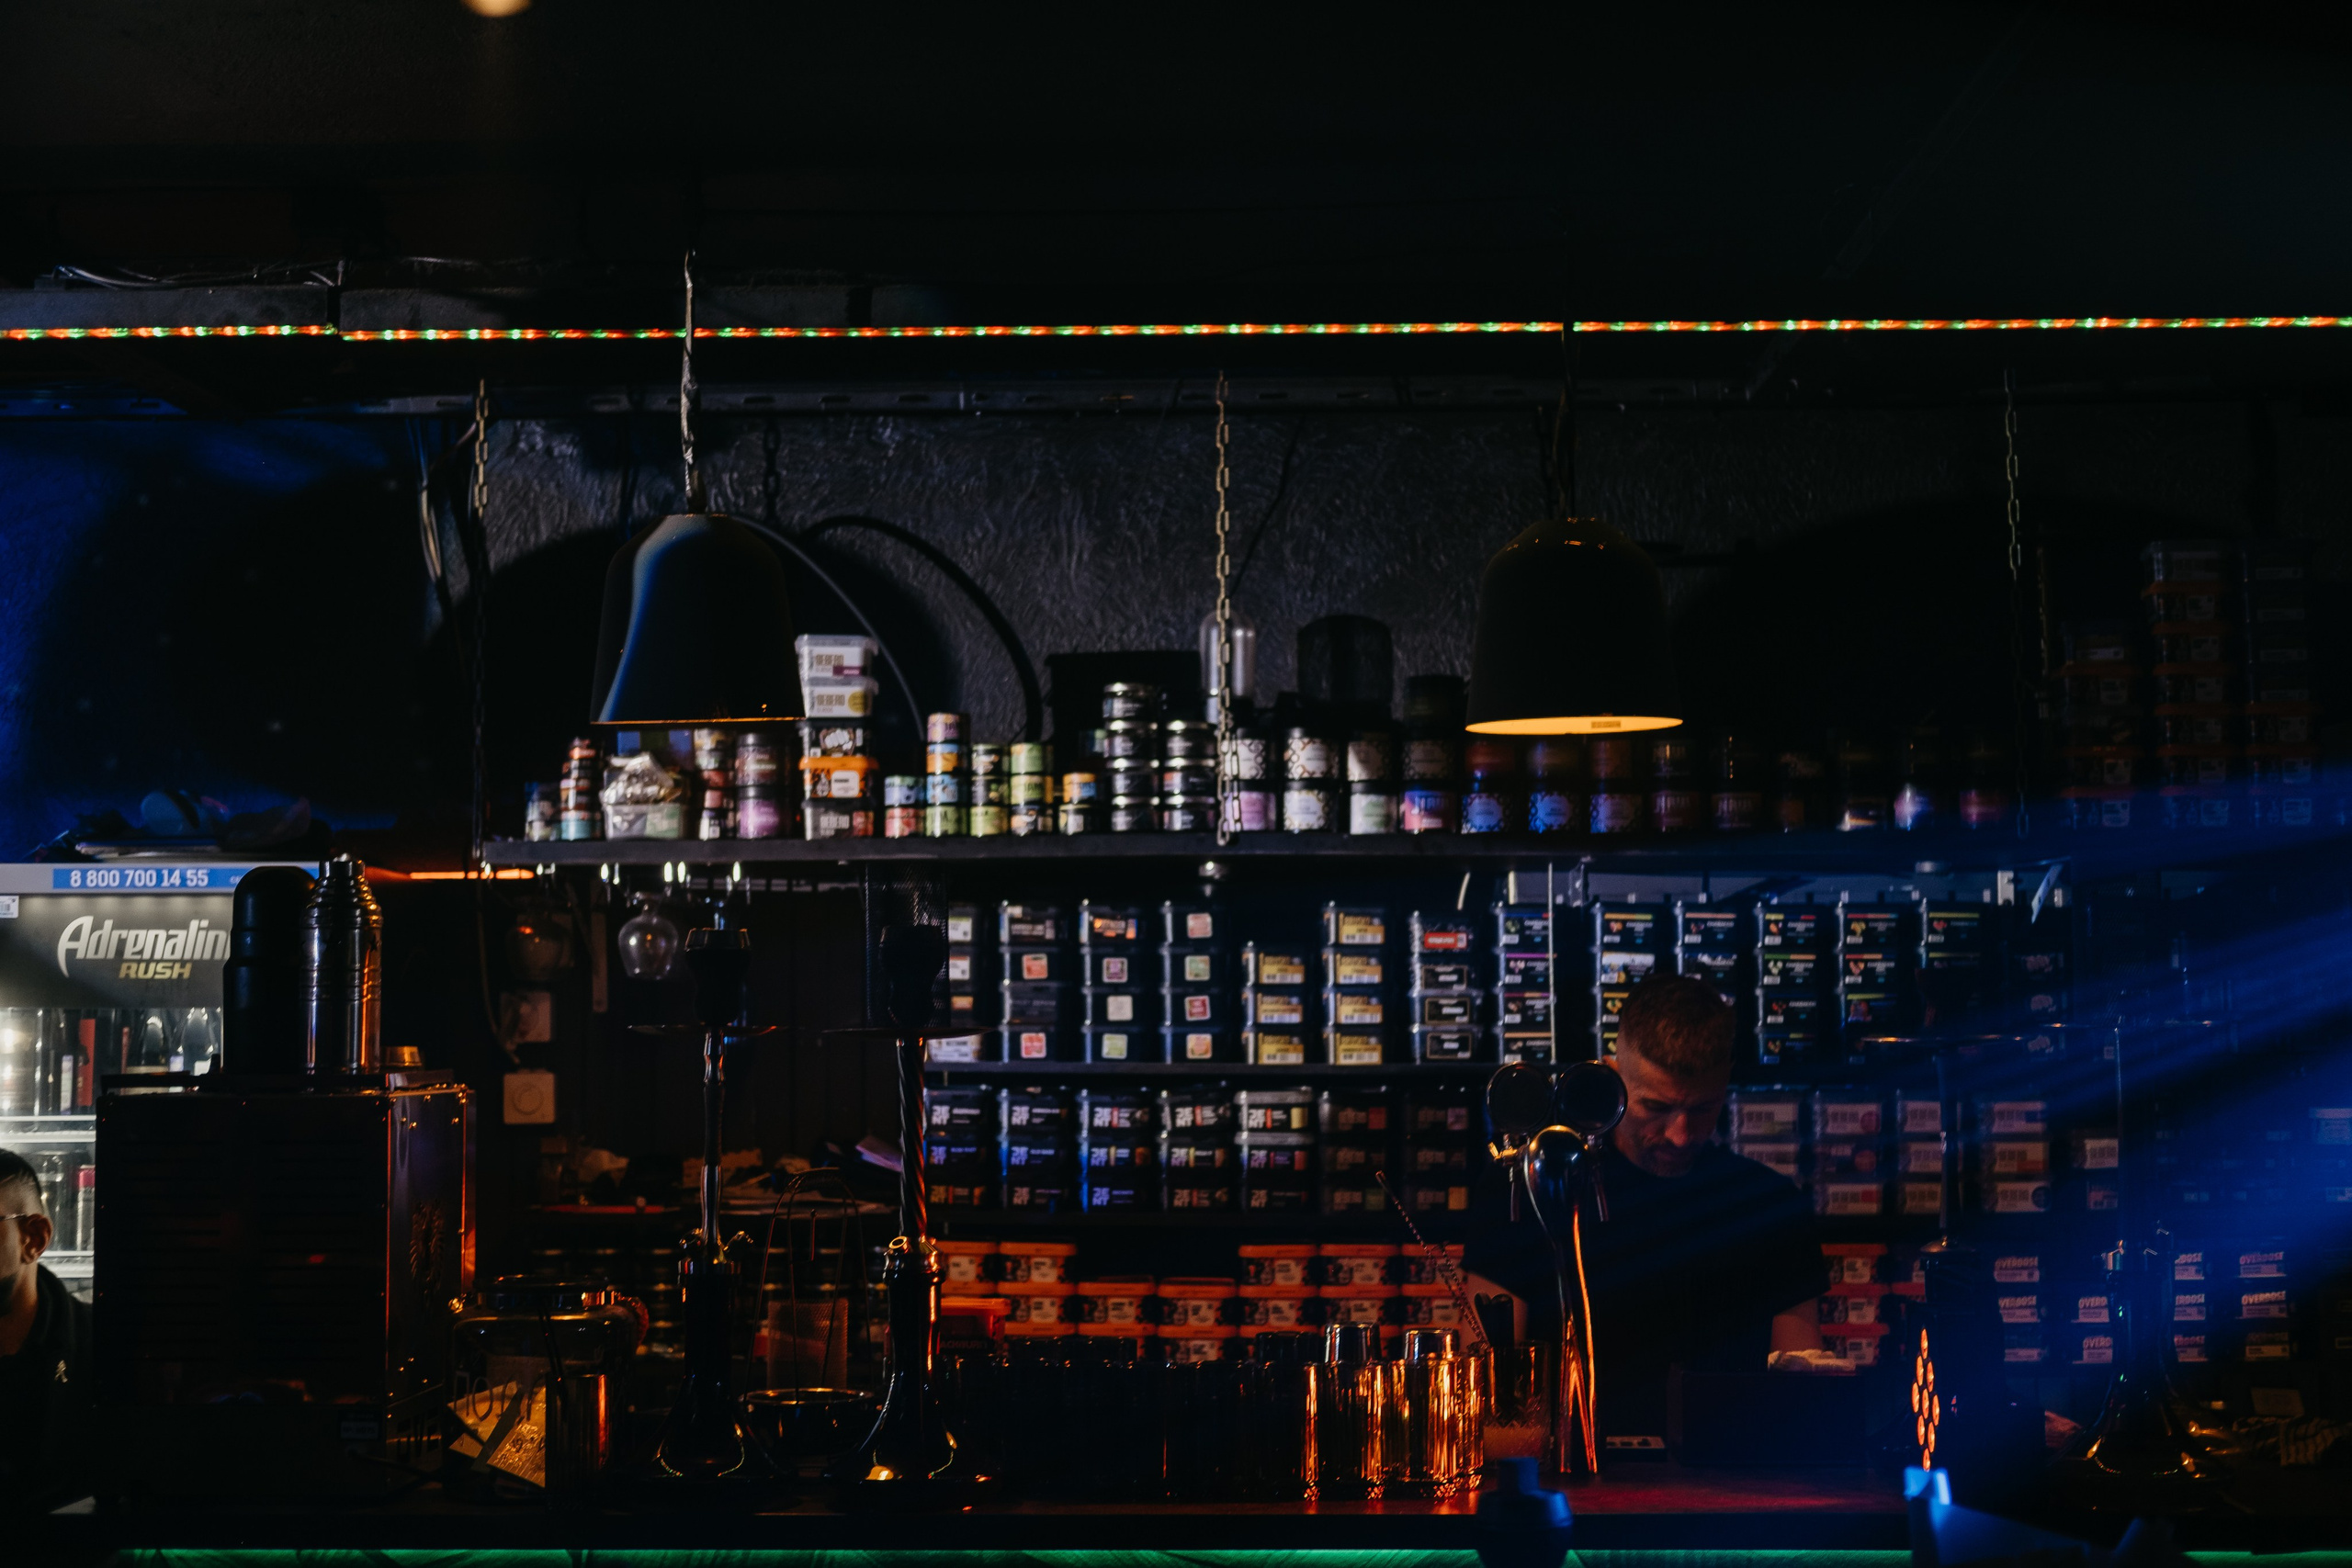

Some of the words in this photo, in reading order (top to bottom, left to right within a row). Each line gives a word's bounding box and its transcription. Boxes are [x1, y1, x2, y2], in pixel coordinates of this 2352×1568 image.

[70, 870, 82, 887] 8
[86, 870, 120, 887] 800
[125, 870, 157, 887] 700
[161, 870, 181, 887] 14
[186, 869, 209, 887] 55
[57, 915, 231, 977] Adrenalin
[119, 962, 193, 979] RUSH
